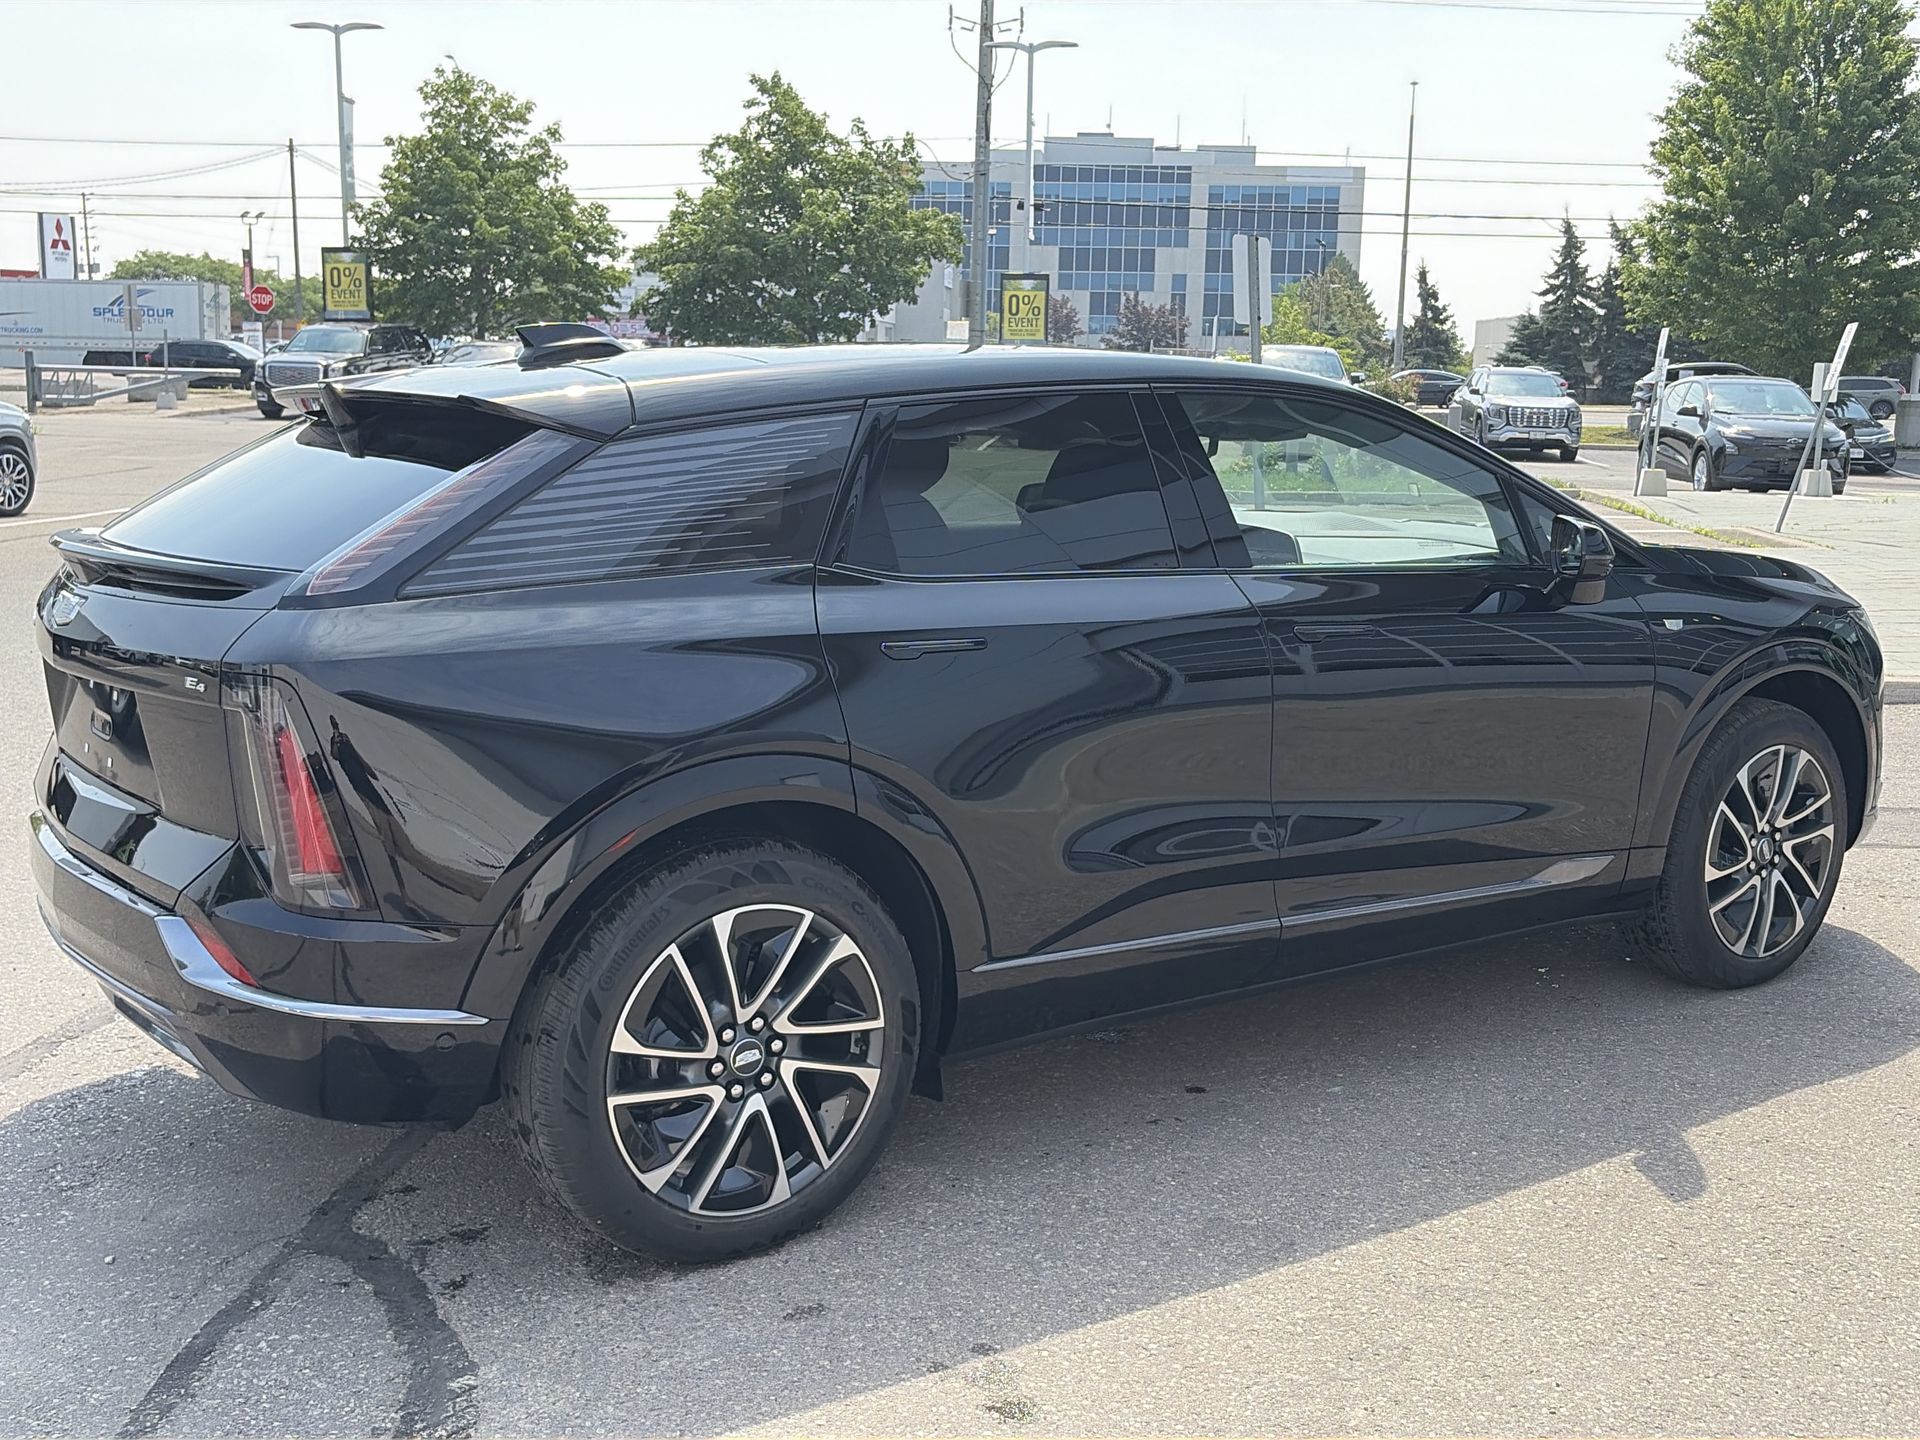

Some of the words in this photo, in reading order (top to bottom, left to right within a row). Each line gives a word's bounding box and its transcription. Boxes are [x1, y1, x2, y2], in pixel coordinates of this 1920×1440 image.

[330, 266, 362, 289] 0%
[251, 293, 273, 306] STOP
[331, 289, 362, 300] EVENT
[1008, 294, 1041, 317] 0%
[92, 307, 175, 318] SPLEOUR
[103, 317, 146, 325] TRUC
[1008, 317, 1041, 328] EVENT
[184, 676, 206, 693] E4
[597, 910, 664, 992] Continental
